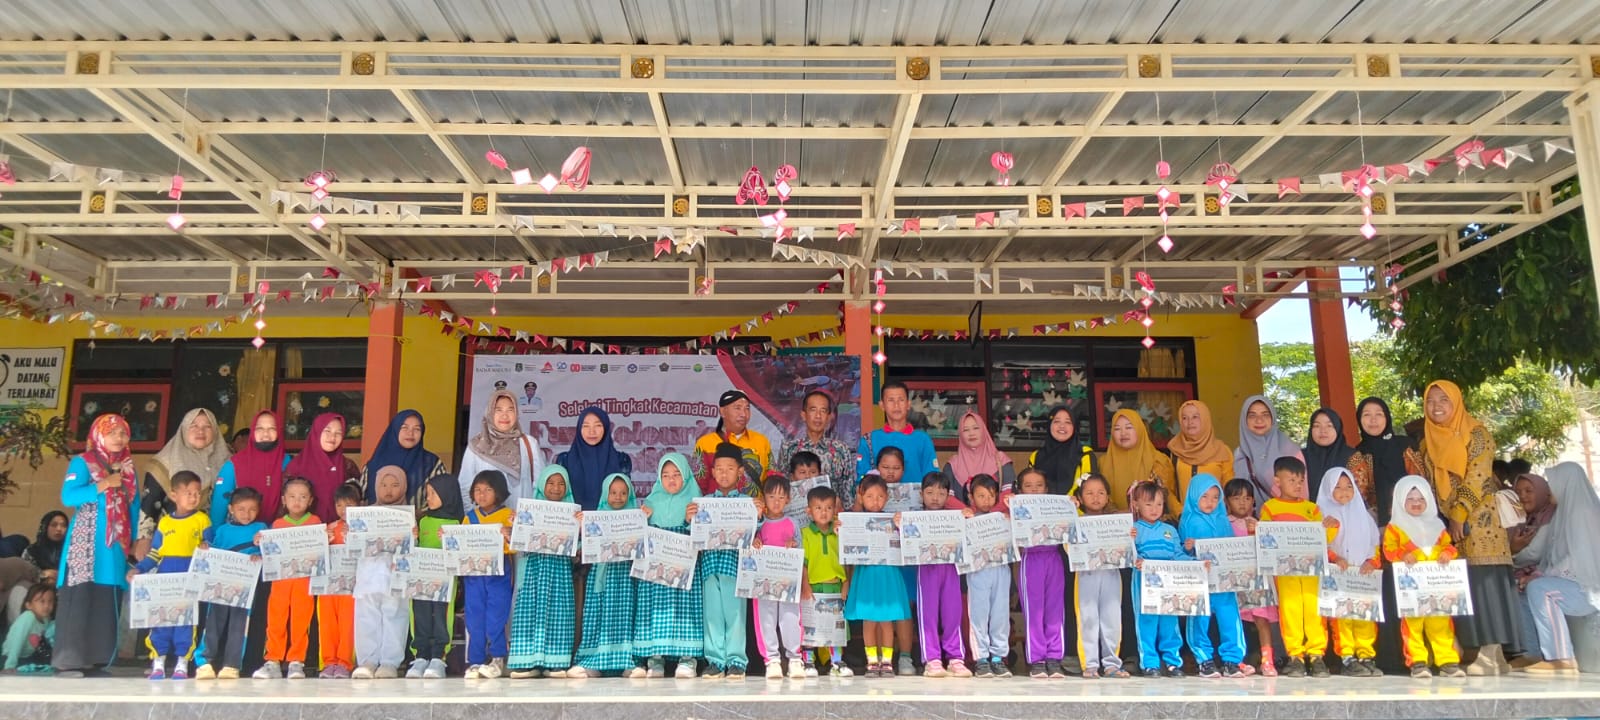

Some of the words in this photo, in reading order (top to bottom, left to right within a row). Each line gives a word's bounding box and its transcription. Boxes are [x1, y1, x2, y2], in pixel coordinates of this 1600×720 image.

[14, 357, 32, 367] AKU
[34, 357, 57, 367] MALU
[17, 373, 50, 383] DATANG
[7, 388, 56, 399] TERLAMBAT
[604, 398, 648, 416] Tingkat
[651, 398, 718, 417] Kecamatan
[1259, 527, 1285, 535] RADAR
[1286, 526, 1321, 534] MADURA
